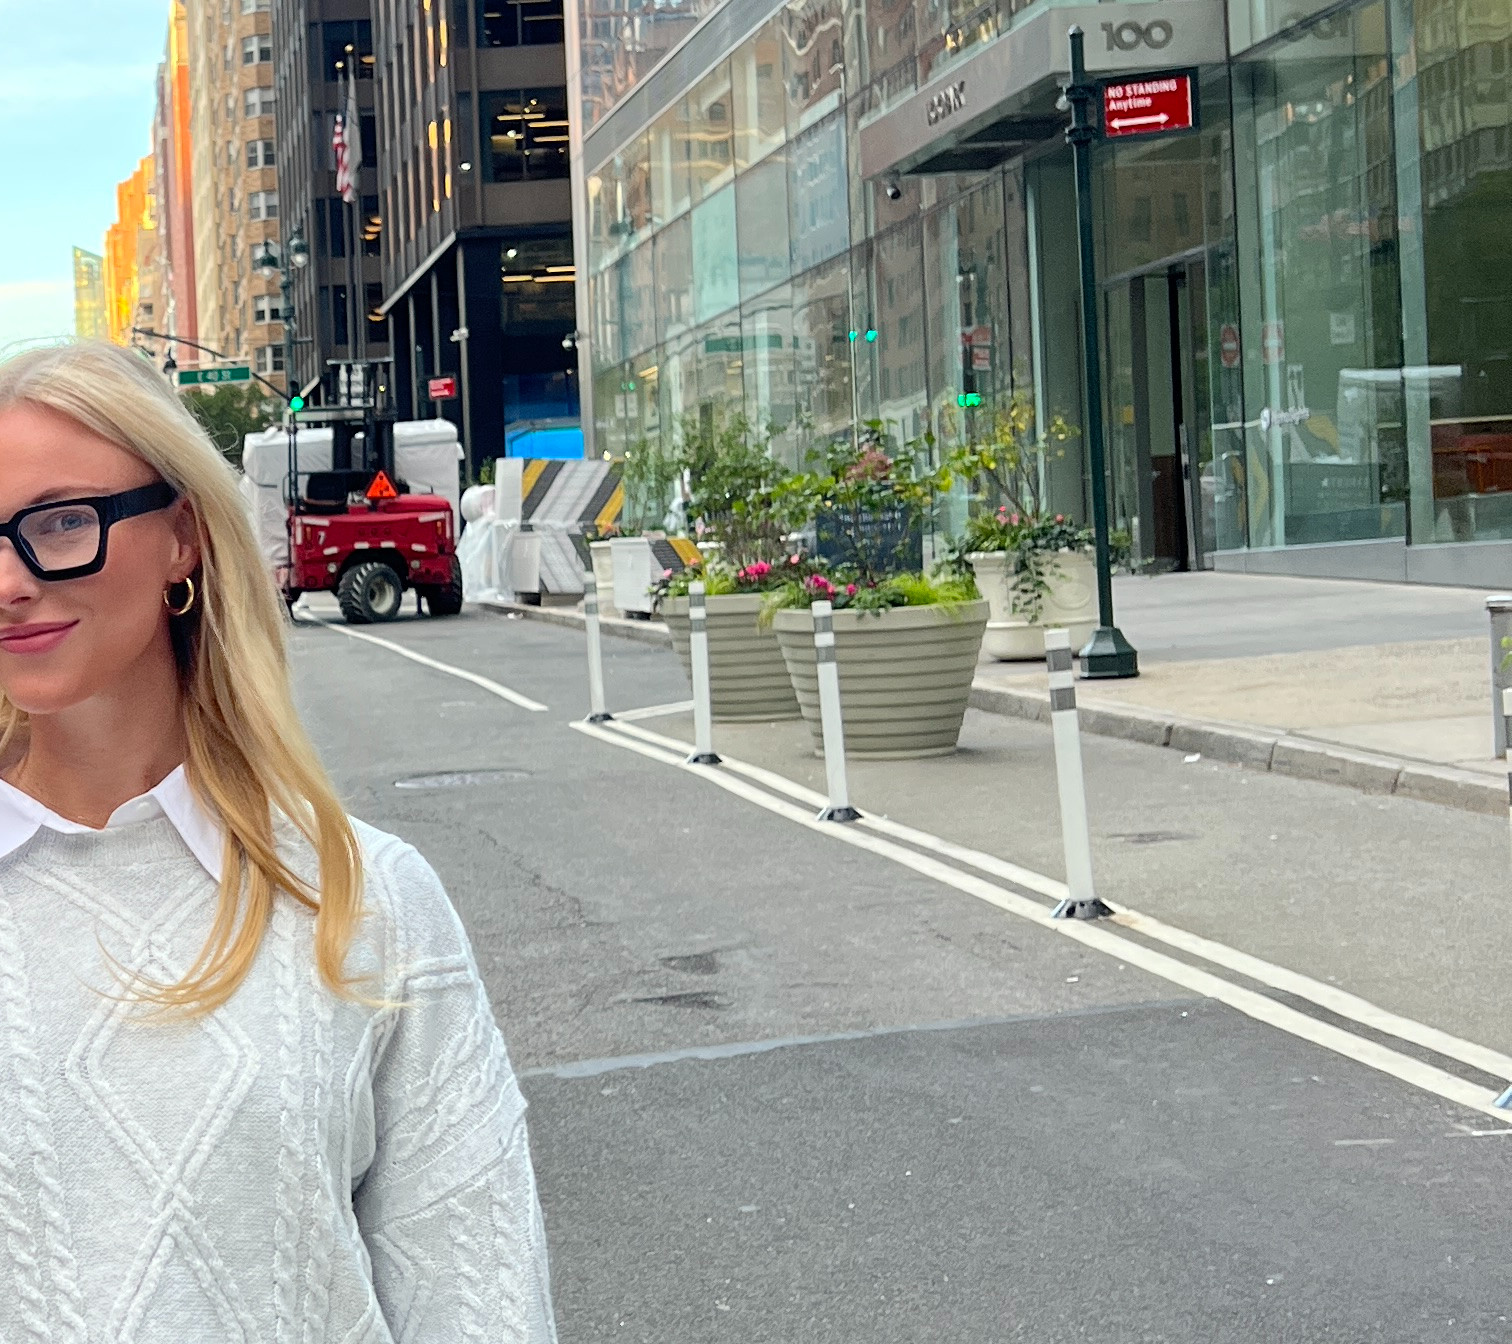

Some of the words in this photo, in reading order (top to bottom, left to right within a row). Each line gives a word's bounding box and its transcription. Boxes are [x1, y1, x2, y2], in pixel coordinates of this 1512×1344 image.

[1101, 19, 1173, 51] 100
[1108, 86, 1123, 98] NO
[1125, 79, 1177, 97] STANDING
[1109, 96, 1152, 112] Anytime
